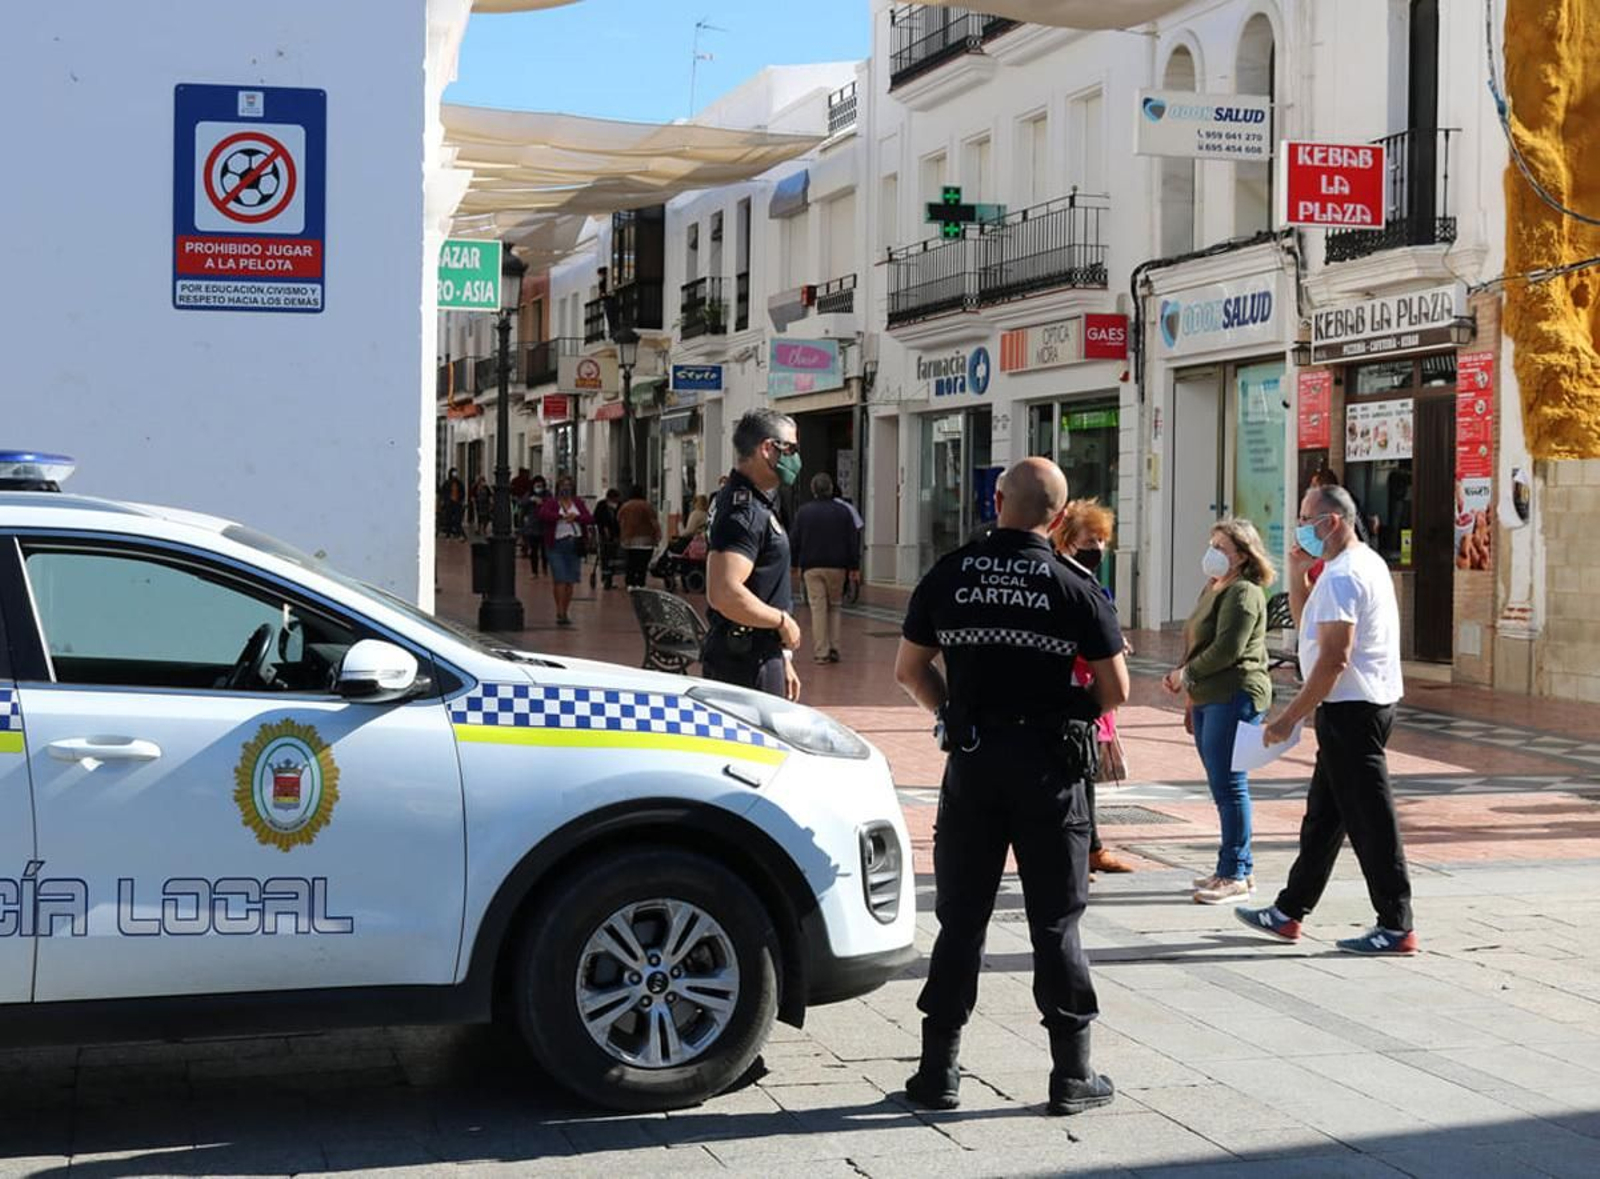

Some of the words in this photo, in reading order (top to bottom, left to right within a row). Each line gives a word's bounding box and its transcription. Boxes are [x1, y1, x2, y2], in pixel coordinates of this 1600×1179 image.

[1298, 145, 1373, 169] KEBAB
[1321, 174, 1350, 195] LA
[1298, 201, 1372, 223] PLAZA
[185, 242, 262, 254] PROHIBIDO
[265, 244, 313, 257] JUGAR
[437, 246, 481, 269] AZAR
[204, 257, 215, 269] A
[218, 258, 236, 269] LA
[239, 259, 293, 271] PELOTA
[178, 294, 226, 304] RESPETO
[227, 296, 258, 305] HACIA
[261, 296, 281, 306] LOS
[180, 284, 202, 294] POR
[310, 287, 318, 296] Y
[462, 280, 495, 302] ASIA
[1314, 306, 1366, 341] KEBAB
[1370, 302, 1391, 332] LA
[1397, 291, 1453, 328] PLAZA
[1087, 327, 1125, 341] GAES
[917, 350, 966, 381] farmacia
[935, 374, 966, 396] mora
[961, 556, 1051, 577] POLICIA
[980, 574, 1028, 587] LOCAL
[955, 587, 1050, 611] CARTAYA
[117, 877, 354, 936] LOCAL
